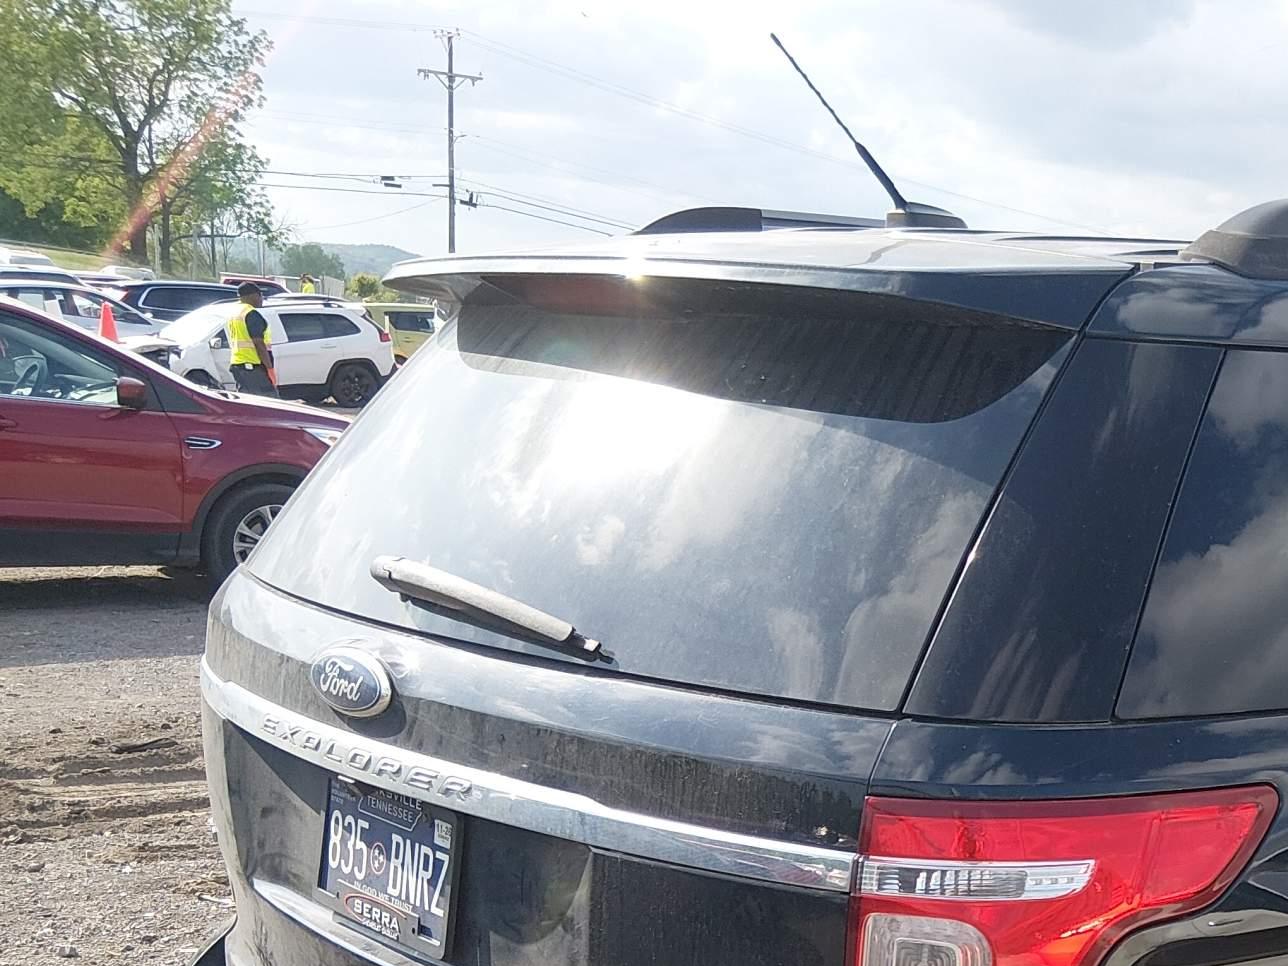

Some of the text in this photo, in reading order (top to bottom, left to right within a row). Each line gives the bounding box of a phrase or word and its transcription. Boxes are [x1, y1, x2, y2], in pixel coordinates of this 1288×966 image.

[320, 657, 364, 702] Ford
[261, 711, 473, 802] EXPLORER
[367, 795, 413, 823] TENNESSEE
[328, 809, 450, 918] 835 BNRZ
[353, 899, 399, 930] SERRA
